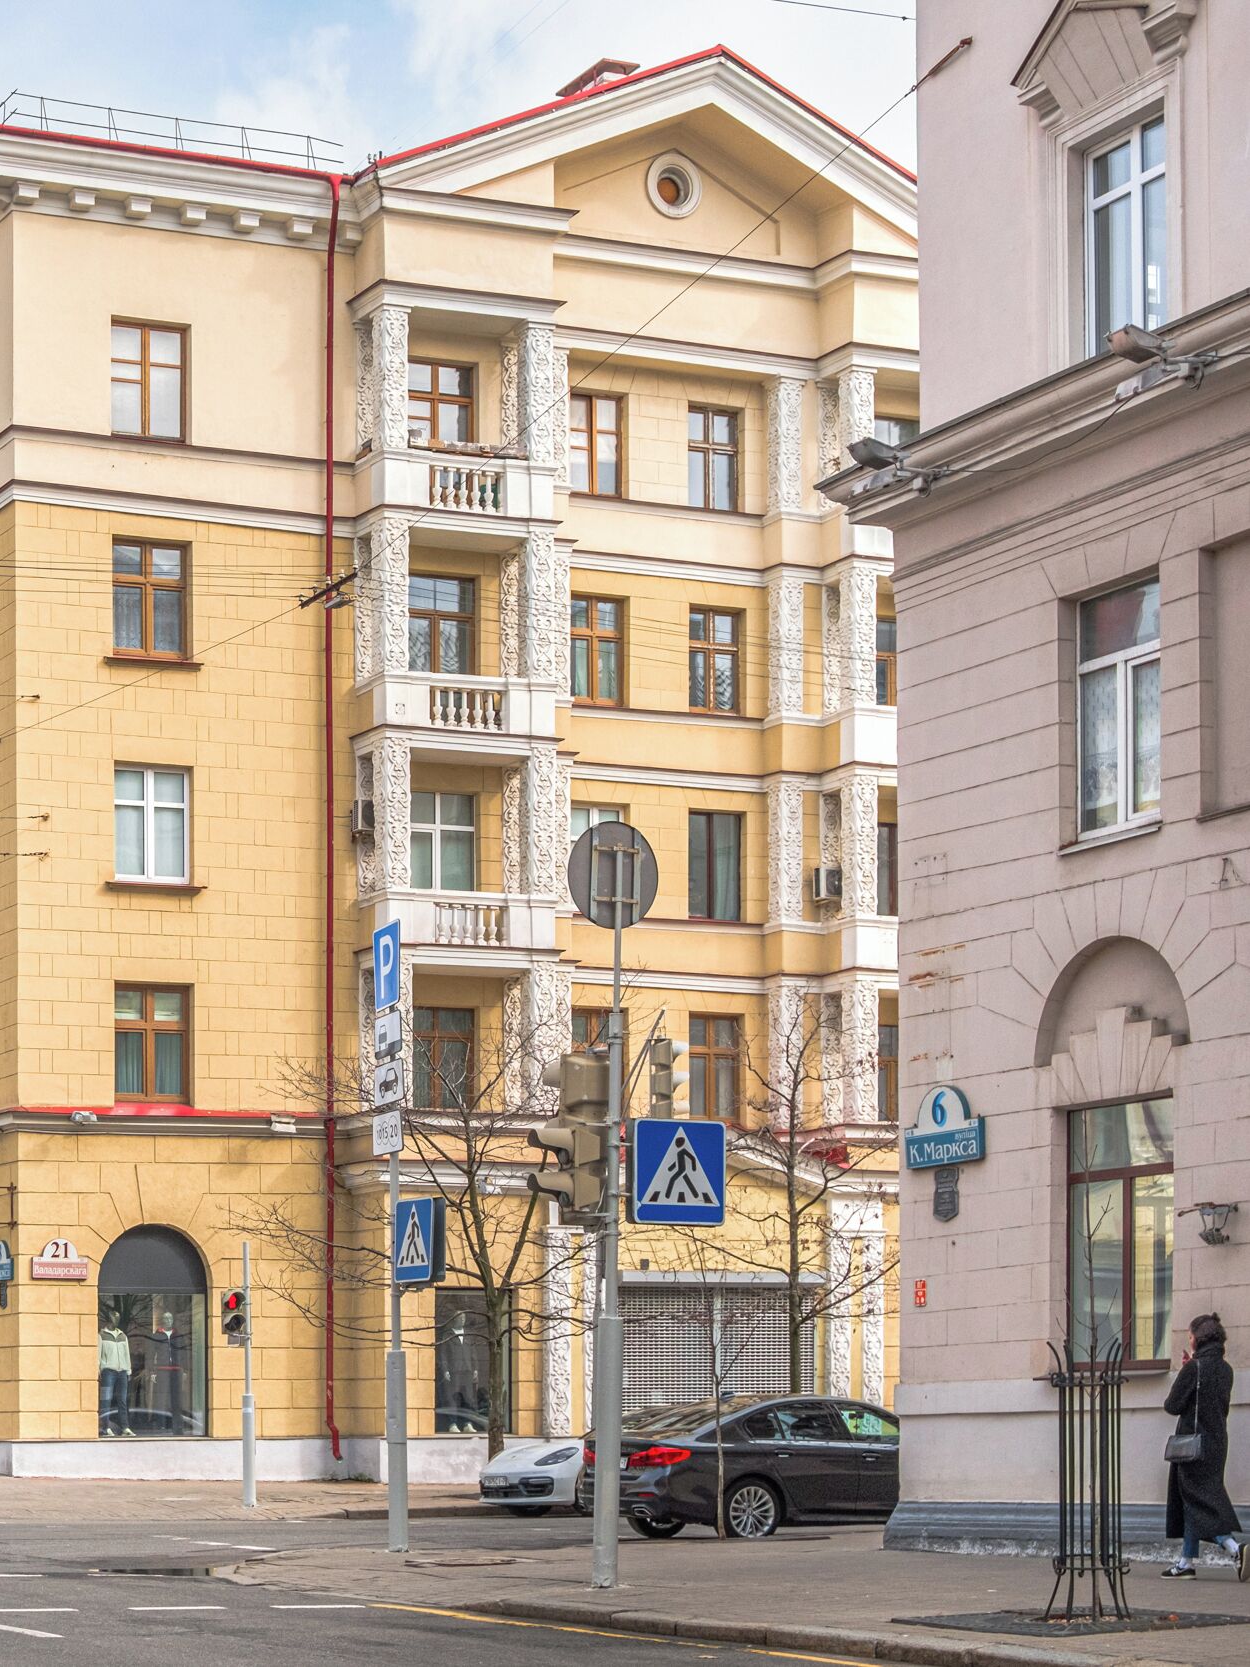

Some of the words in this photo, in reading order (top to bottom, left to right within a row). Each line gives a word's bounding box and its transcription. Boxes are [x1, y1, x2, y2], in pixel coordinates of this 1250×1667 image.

[380, 934, 394, 999] P
[931, 1090, 948, 1128] 6
[390, 1124, 398, 1138] 20
[910, 1139, 977, 1163] К.Маркса
[50, 1241, 69, 1258] 21
